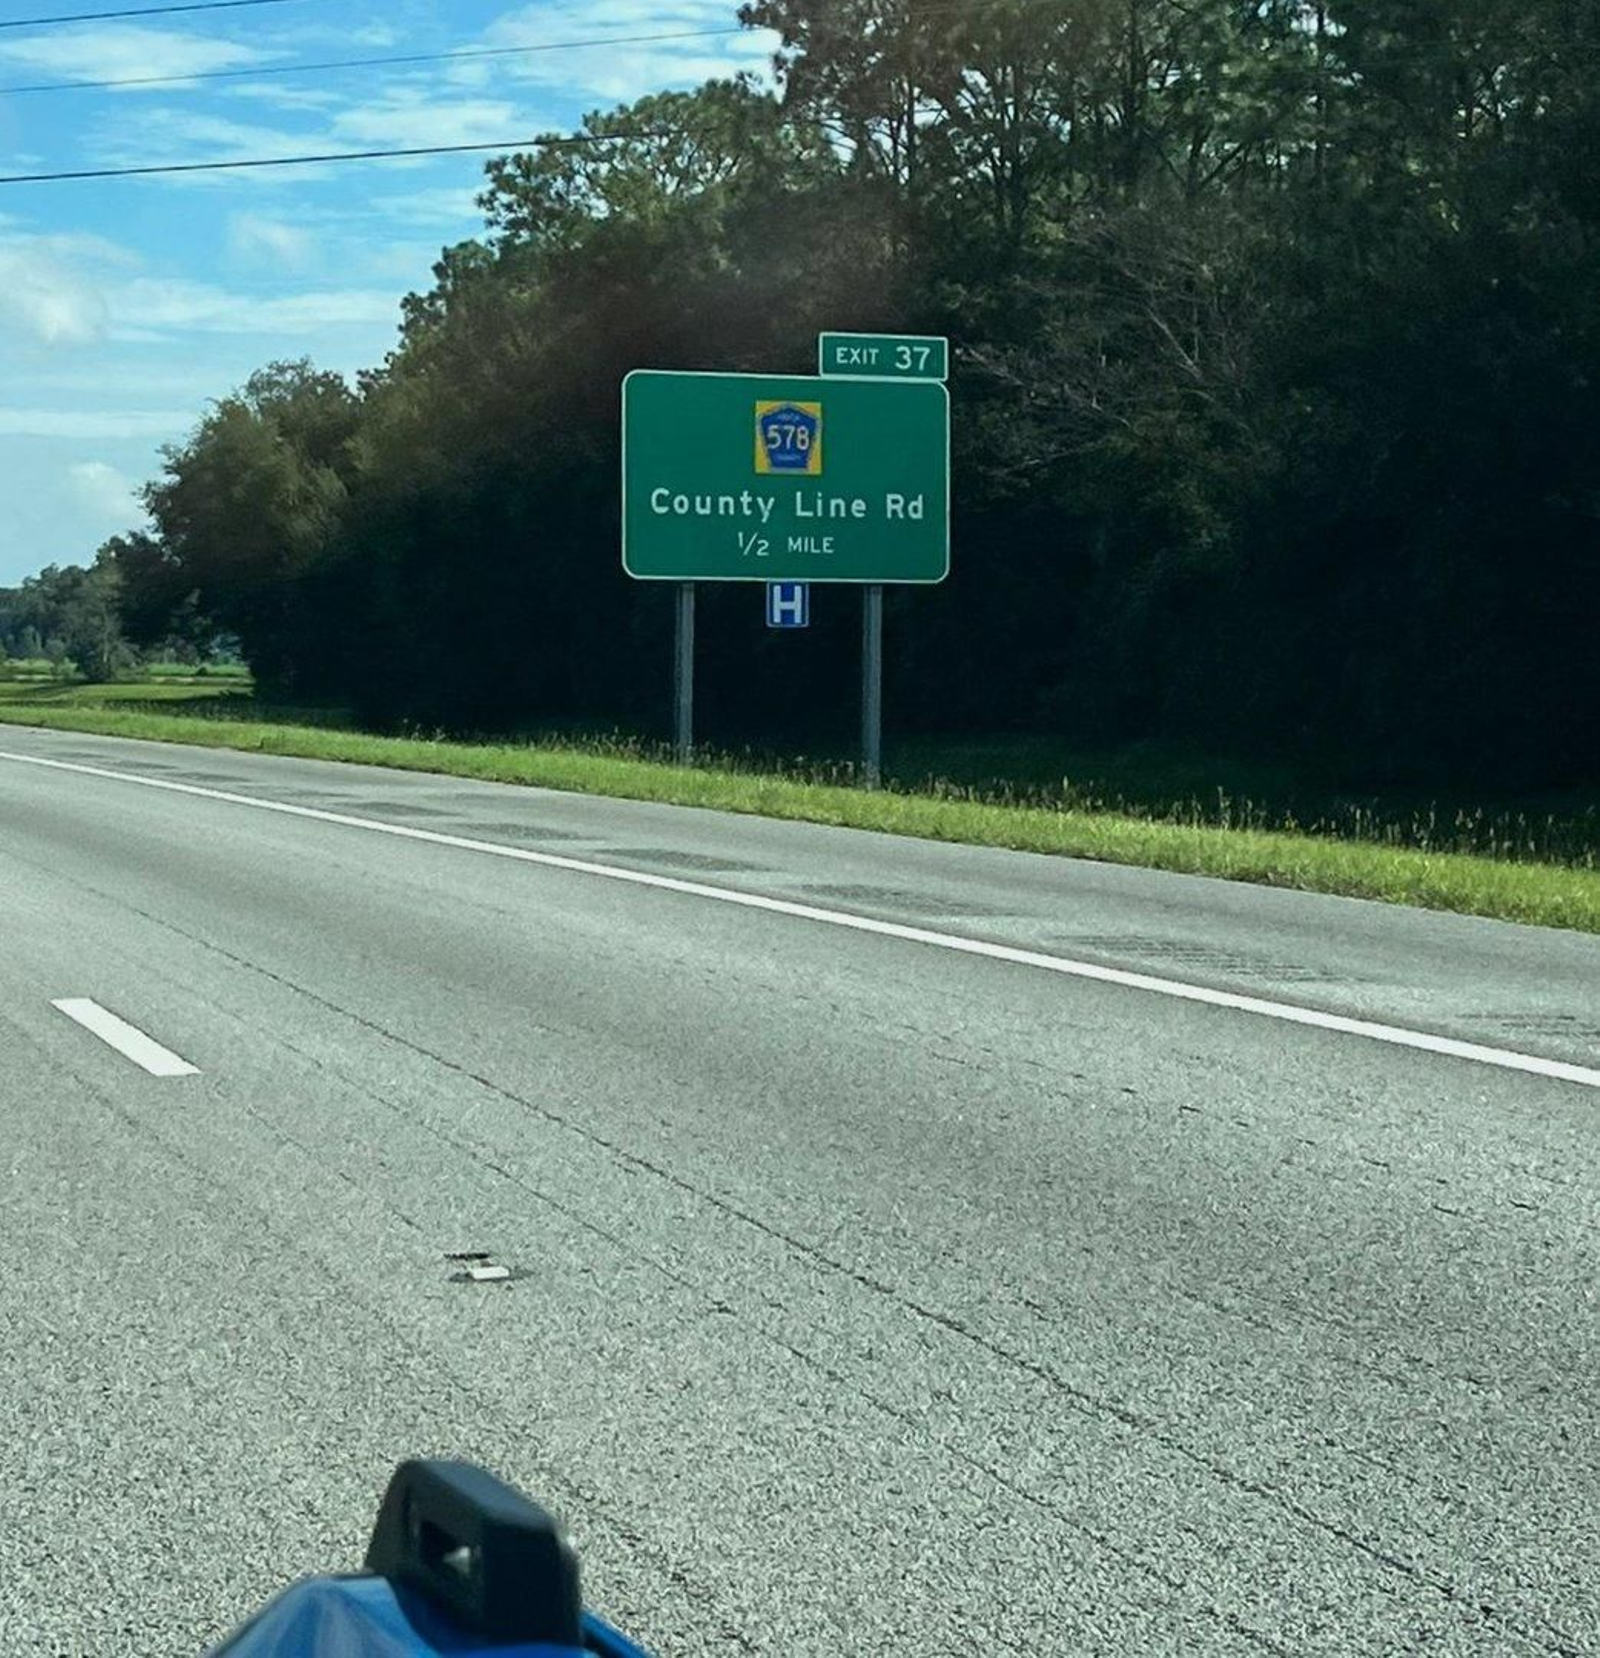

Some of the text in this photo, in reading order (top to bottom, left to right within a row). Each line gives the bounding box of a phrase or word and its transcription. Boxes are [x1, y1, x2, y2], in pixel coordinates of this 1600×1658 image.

[836, 346, 931, 371] EXIT 37
[767, 425, 809, 450] 578
[650, 488, 924, 523] County Line Rd
[738, 532, 835, 556] 1/2 MILE
[773, 585, 802, 623] H
